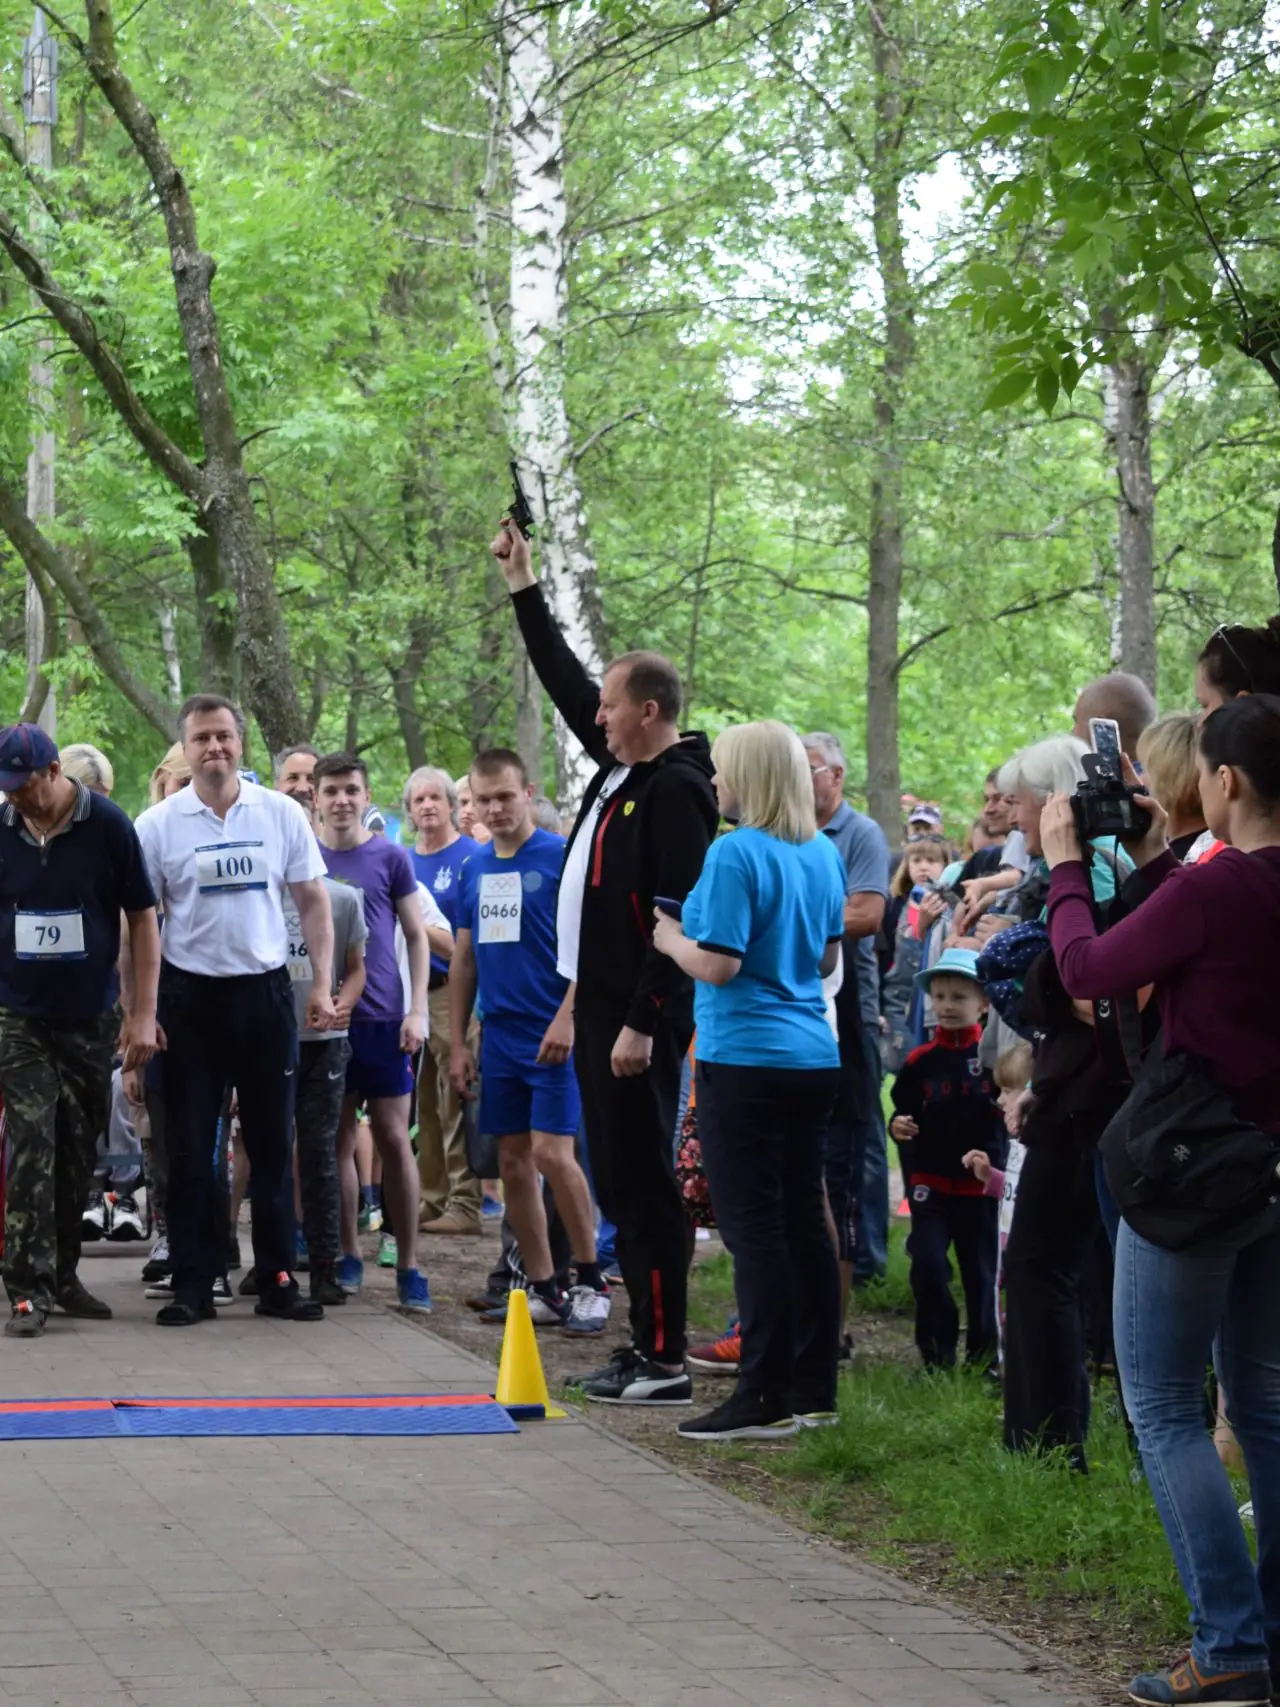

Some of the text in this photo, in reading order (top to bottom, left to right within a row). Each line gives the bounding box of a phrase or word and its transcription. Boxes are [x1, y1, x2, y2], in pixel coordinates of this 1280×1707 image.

[215, 855, 253, 878] 100
[480, 903, 518, 919] 0466
[35, 925, 61, 946] 79
[289, 942, 308, 957] 46
